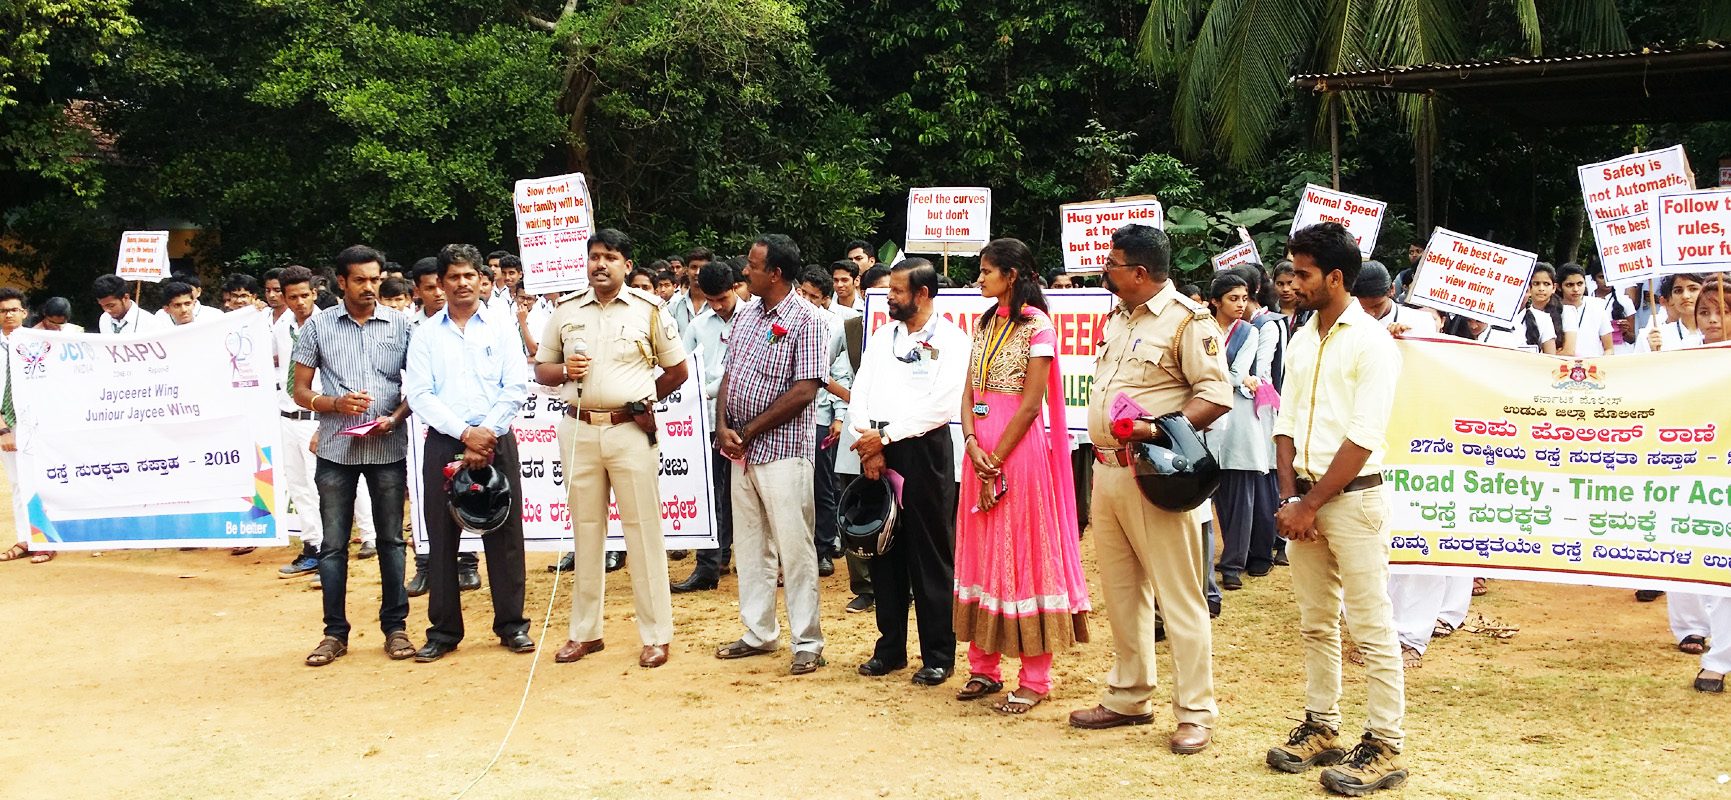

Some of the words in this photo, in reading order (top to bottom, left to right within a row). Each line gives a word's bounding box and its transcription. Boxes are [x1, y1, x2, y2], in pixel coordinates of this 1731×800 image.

[1603, 163, 1645, 181] Safety
[1648, 159, 1662, 171] is
[527, 187, 544, 196] Slow
[547, 185, 564, 194] down
[1589, 188, 1611, 203] not
[1615, 174, 1687, 198] Automatic,
[518, 203, 532, 214] Your
[534, 200, 556, 213] family
[559, 197, 573, 208] will
[575, 196, 584, 207] be
[913, 194, 932, 204] Feel
[936, 194, 950, 204] the
[953, 195, 985, 204] curves
[1307, 191, 1341, 209] Normal
[1344, 200, 1379, 217] Speed
[1664, 198, 1719, 214] Follow
[927, 209, 942, 219] but
[946, 209, 968, 220] don't
[1067, 213, 1092, 224] Hug
[1096, 212, 1124, 223] your
[1128, 208, 1155, 219] kids
[1595, 204, 1630, 219] think
[1634, 200, 1648, 213] ab
[525, 217, 551, 230] waiting
[553, 216, 563, 226] for
[565, 216, 579, 227] you
[925, 225, 942, 238] hug
[945, 225, 969, 236] them
[1086, 227, 1098, 236] at
[1102, 226, 1121, 235] ho
[1607, 223, 1626, 236] The
[1628, 217, 1650, 232] best
[1678, 220, 1725, 236] rules,
[1069, 242, 1090, 252] but
[1453, 240, 1468, 255] The
[1470, 246, 1492, 261] best
[1493, 252, 1507, 265] Car
[1603, 245, 1619, 256] are
[1677, 245, 1714, 261] your
[1081, 256, 1091, 265] in
[1427, 251, 1454, 270] Safety
[1456, 260, 1485, 276] device
[1487, 267, 1494, 279] is
[1495, 272, 1501, 281] a
[1503, 274, 1524, 287] rear
[1619, 258, 1644, 273] must
[1445, 274, 1466, 288] view
[1468, 282, 1495, 295] mirror
[1430, 287, 1449, 300] with
[1451, 294, 1457, 302] a
[1458, 296, 1477, 310] cop
[1478, 299, 1486, 310] in
[1487, 301, 1495, 313] it.
[60, 342, 84, 361] JCI
[105, 341, 167, 363] KAPU
[100, 385, 151, 403] Jayceeret
[155, 384, 179, 399] Wing
[86, 408, 125, 422] Juniour
[128, 407, 164, 422] Jaycee
[167, 403, 200, 417] Wing
[1503, 405, 1547, 416] ಉಡುಪಿ
[1555, 408, 1586, 421] ಜಿಲ್ಲಾ
[1594, 407, 1655, 419] ಪೊಲೀಸ್
[666, 415, 694, 437] ಠಾಣೆ
[1455, 419, 1517, 437] ಕಾಪು
[1532, 423, 1643, 443] ಪೊಲೀಸ್
[1659, 424, 1716, 443] ಠಾಣೆ
[1410, 438, 1454, 453] 27ನೇ
[1462, 443, 1526, 465] ರಾಷ್ಟ್ರೀಯ
[1535, 447, 1561, 466] ರಸ್ತೆ
[1569, 450, 1638, 470] ಸುರಕ್ಷತಾ
[1648, 450, 1697, 470] ಸಪ್ತಾಹ
[46, 463, 68, 483] ರಸ್ತೆ
[75, 461, 130, 481] ಸುರಕ್ಷತಾ
[137, 455, 180, 476] ಸಪ್ತಾಹ
[204, 450, 240, 466] 2016
[1464, 469, 1544, 502] Safety
[1569, 478, 1634, 502] Time
[1643, 480, 1680, 502] for
[1688, 480, 1731, 507] Act
[225, 521, 237, 534] Be
[240, 521, 267, 535] better
[1469, 503, 1552, 534] ಸುರಕ್ಷತೆ
[1589, 509, 1656, 542] ಕ್ರಮಕ್ಕೆ
[1391, 535, 1429, 556] ನಿಮ್ಮ
[1439, 536, 1541, 558] ಸುರಕ್ಷತೆಯೇ
[1552, 541, 1582, 562] ರಸ್ತೆ
[1592, 544, 1692, 565] ನಿಯಮಗಳ
